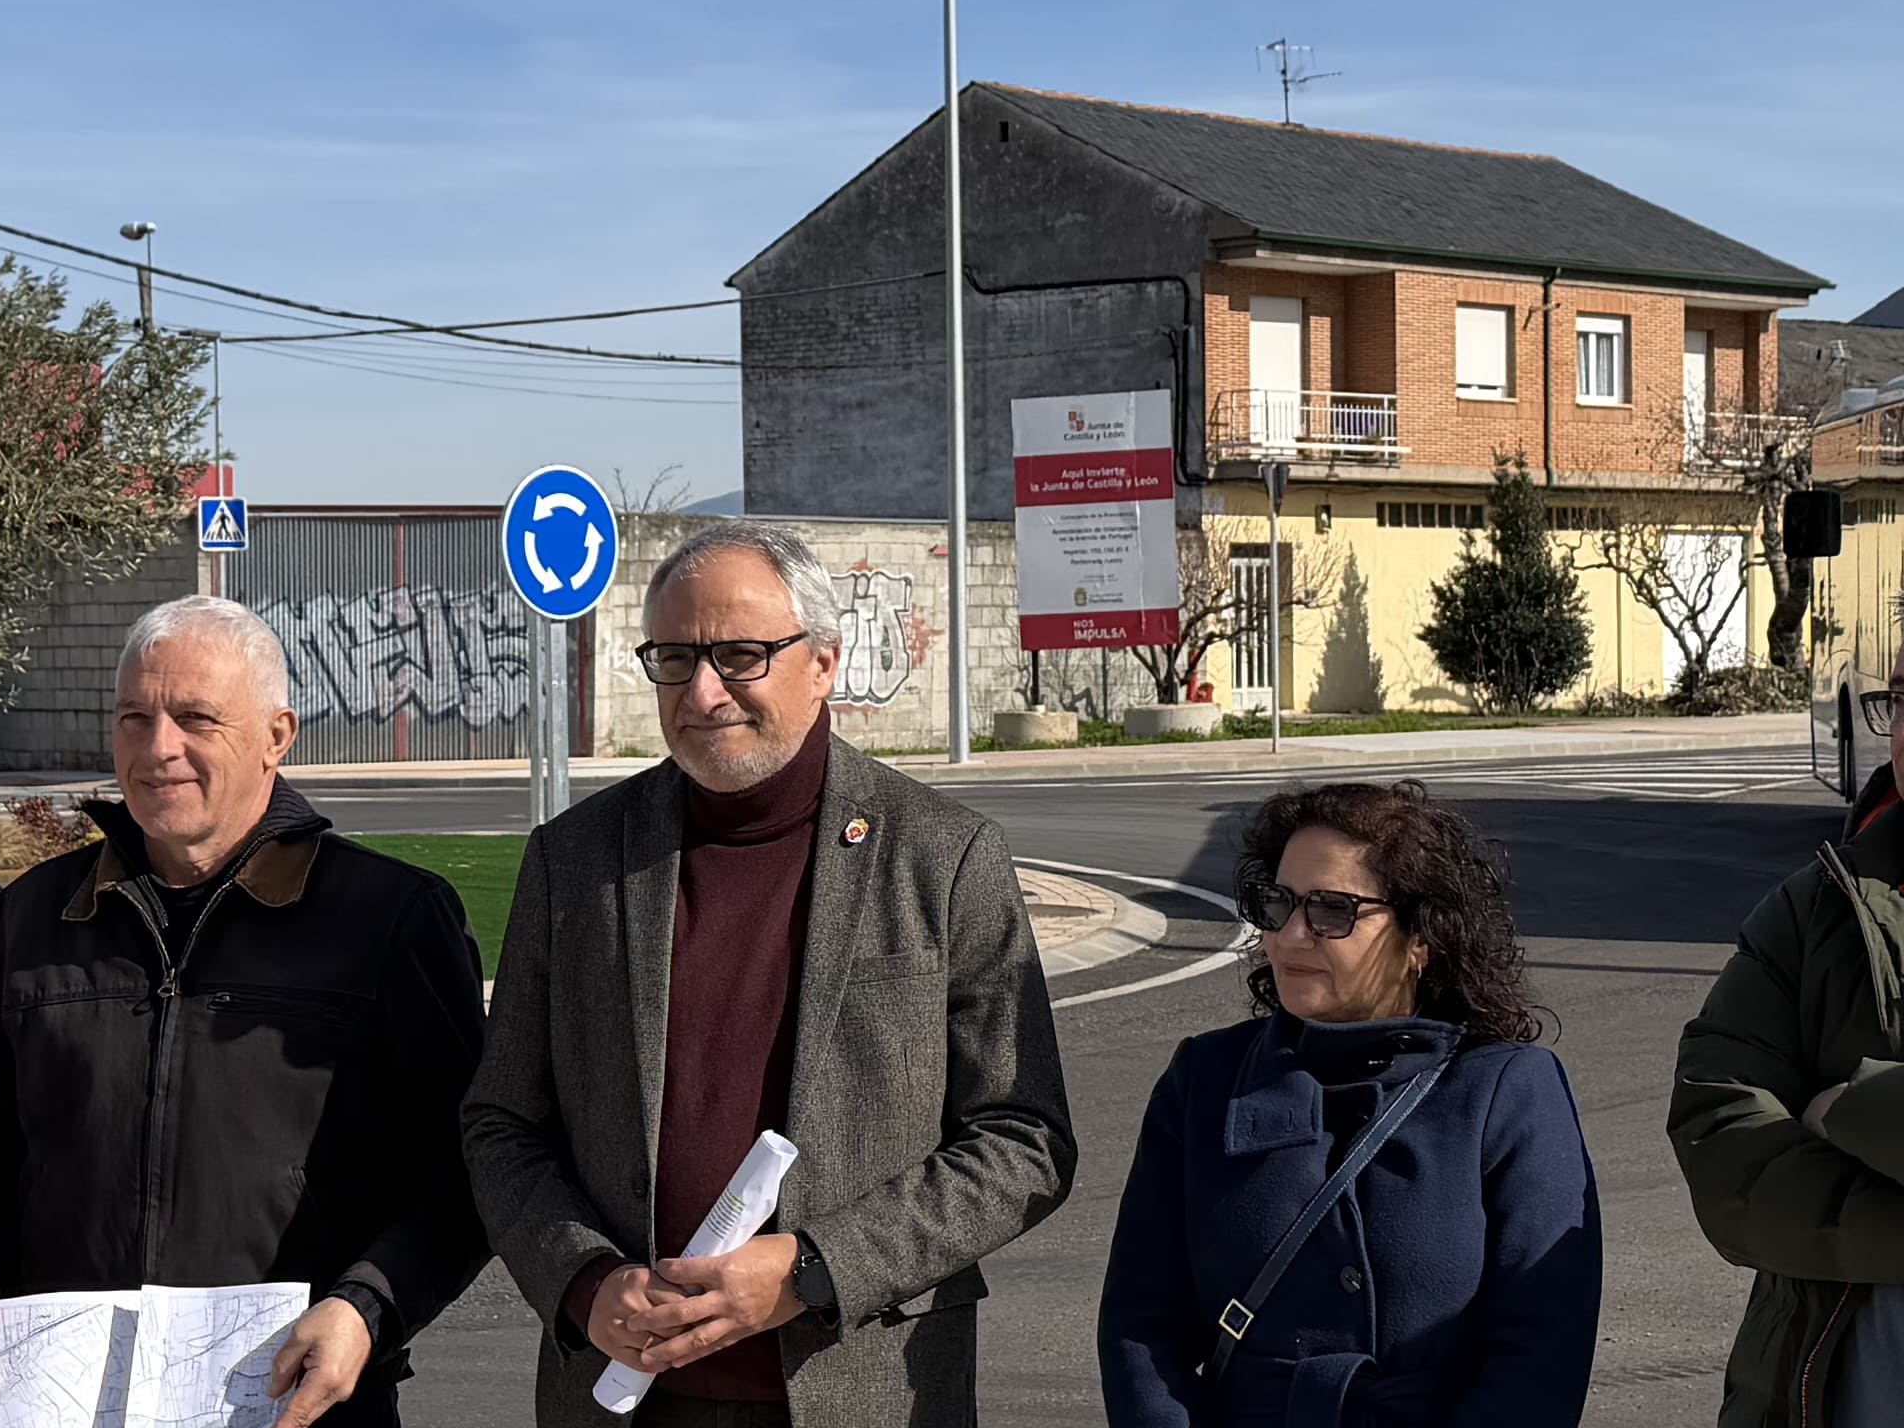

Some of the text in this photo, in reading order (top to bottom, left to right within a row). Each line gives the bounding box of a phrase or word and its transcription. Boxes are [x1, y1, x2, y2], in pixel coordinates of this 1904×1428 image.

[1063, 432, 1094, 441] Castilla
[1103, 430, 1125, 439] León
[1086, 466, 1125, 478] invierte
[1030, 483, 1039, 492] la
[1041, 481, 1070, 491] Junta
[1072, 480, 1084, 490] de
[1086, 478, 1122, 489] Castilla
[1134, 476, 1158, 487] León
